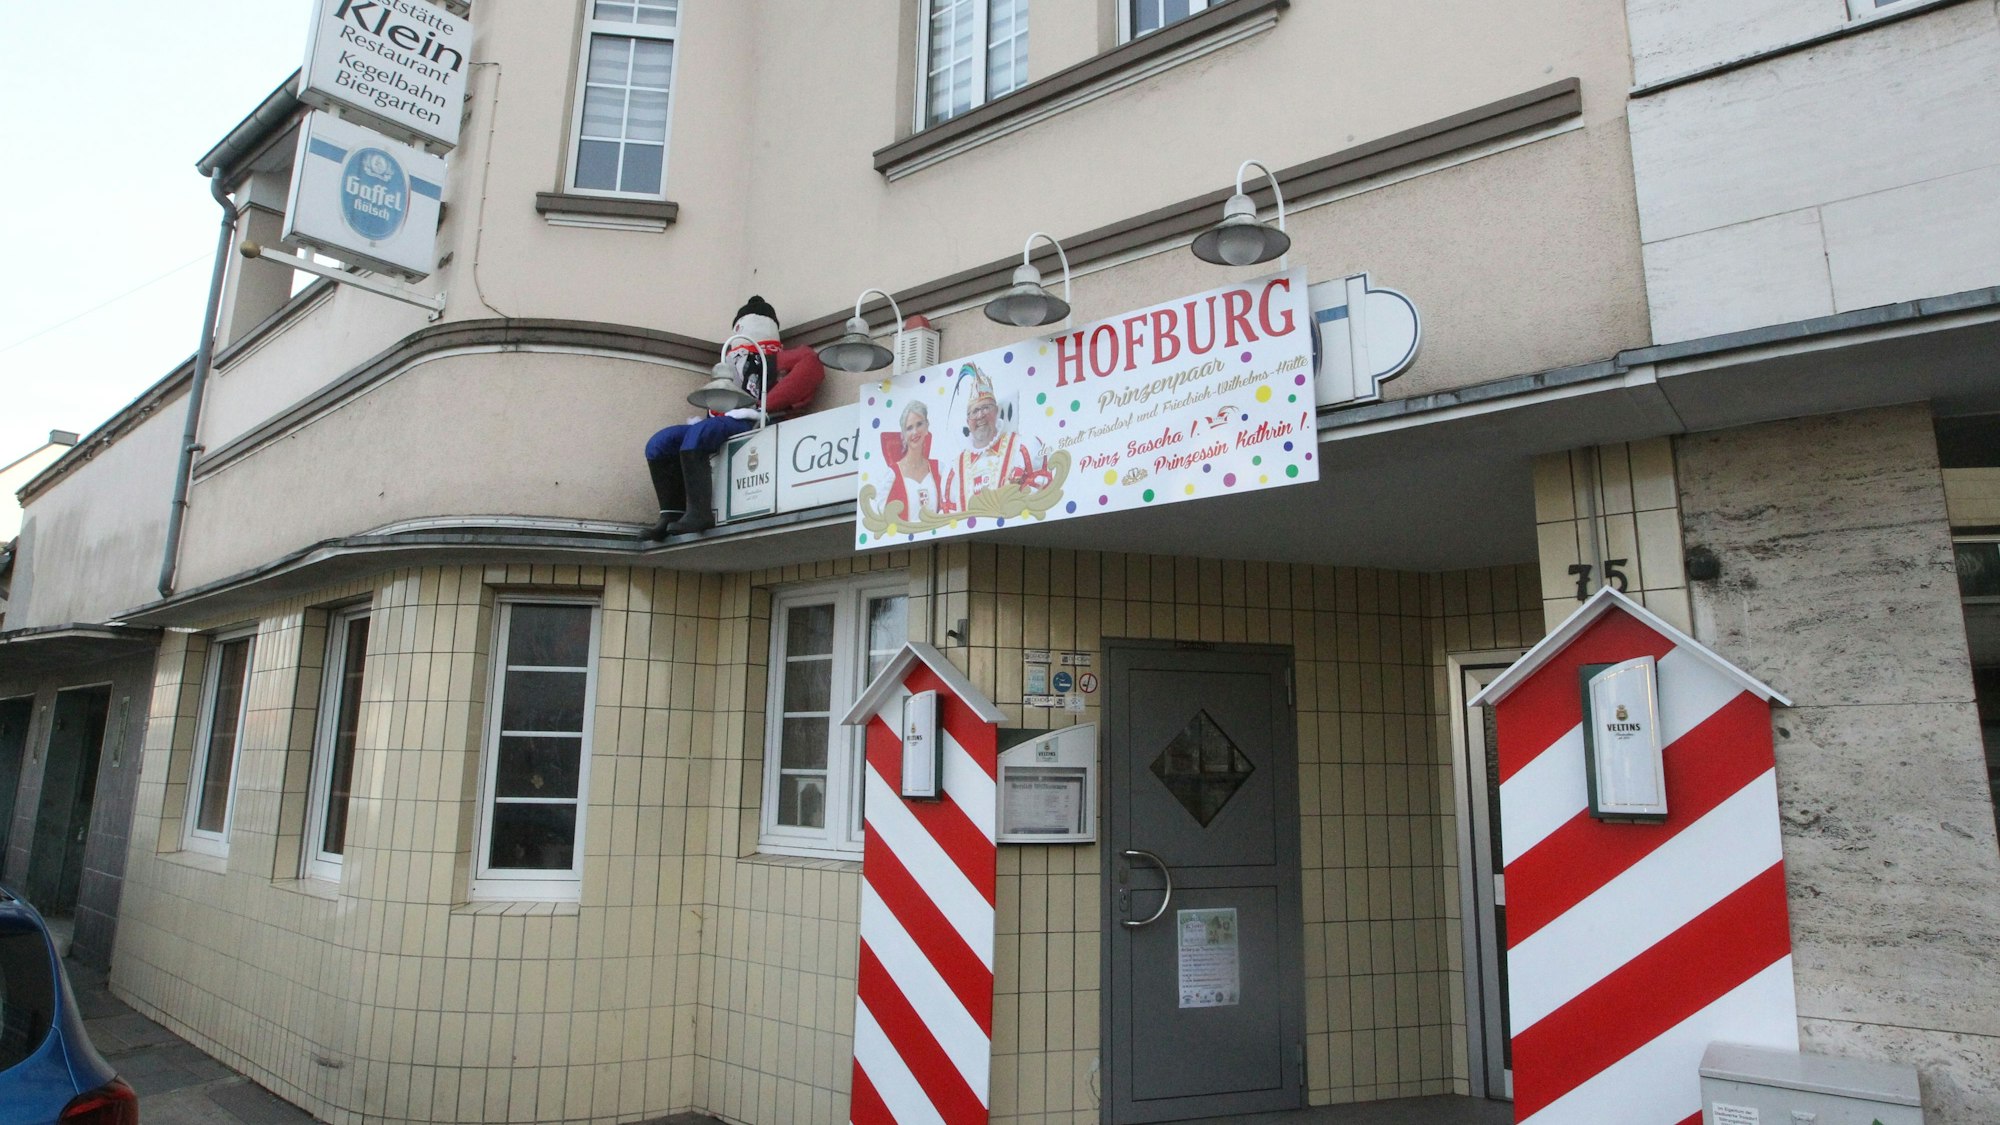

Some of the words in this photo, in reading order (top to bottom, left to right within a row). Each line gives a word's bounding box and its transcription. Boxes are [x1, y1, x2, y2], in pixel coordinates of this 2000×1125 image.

[334, 0, 463, 73] Klein
[379, 0, 454, 35] ststätte
[339, 24, 451, 85] Restaurant
[335, 70, 441, 126] Biergarten
[338, 50, 446, 108] Kegelbahn
[346, 175, 402, 212] Gaffel
[353, 198, 390, 221] Kölsch
[1055, 278, 1296, 388] HOFBURG
[1097, 357, 1225, 414] Prinzenpaar
[1058, 430, 1087, 450] Stadt
[1088, 412, 1134, 440] Troisdorf
[1136, 403, 1159, 423] und
[1154, 440, 1229, 475] Prinzessin
[1236, 420, 1293, 450] Kathrin
[1079, 452, 1121, 474] Prinz
[1127, 427, 1184, 458] Sascha
[736, 471, 770, 490] VELTINS
[1568, 558, 1628, 601] 75
[1606, 723, 1641, 732] VELTINS
